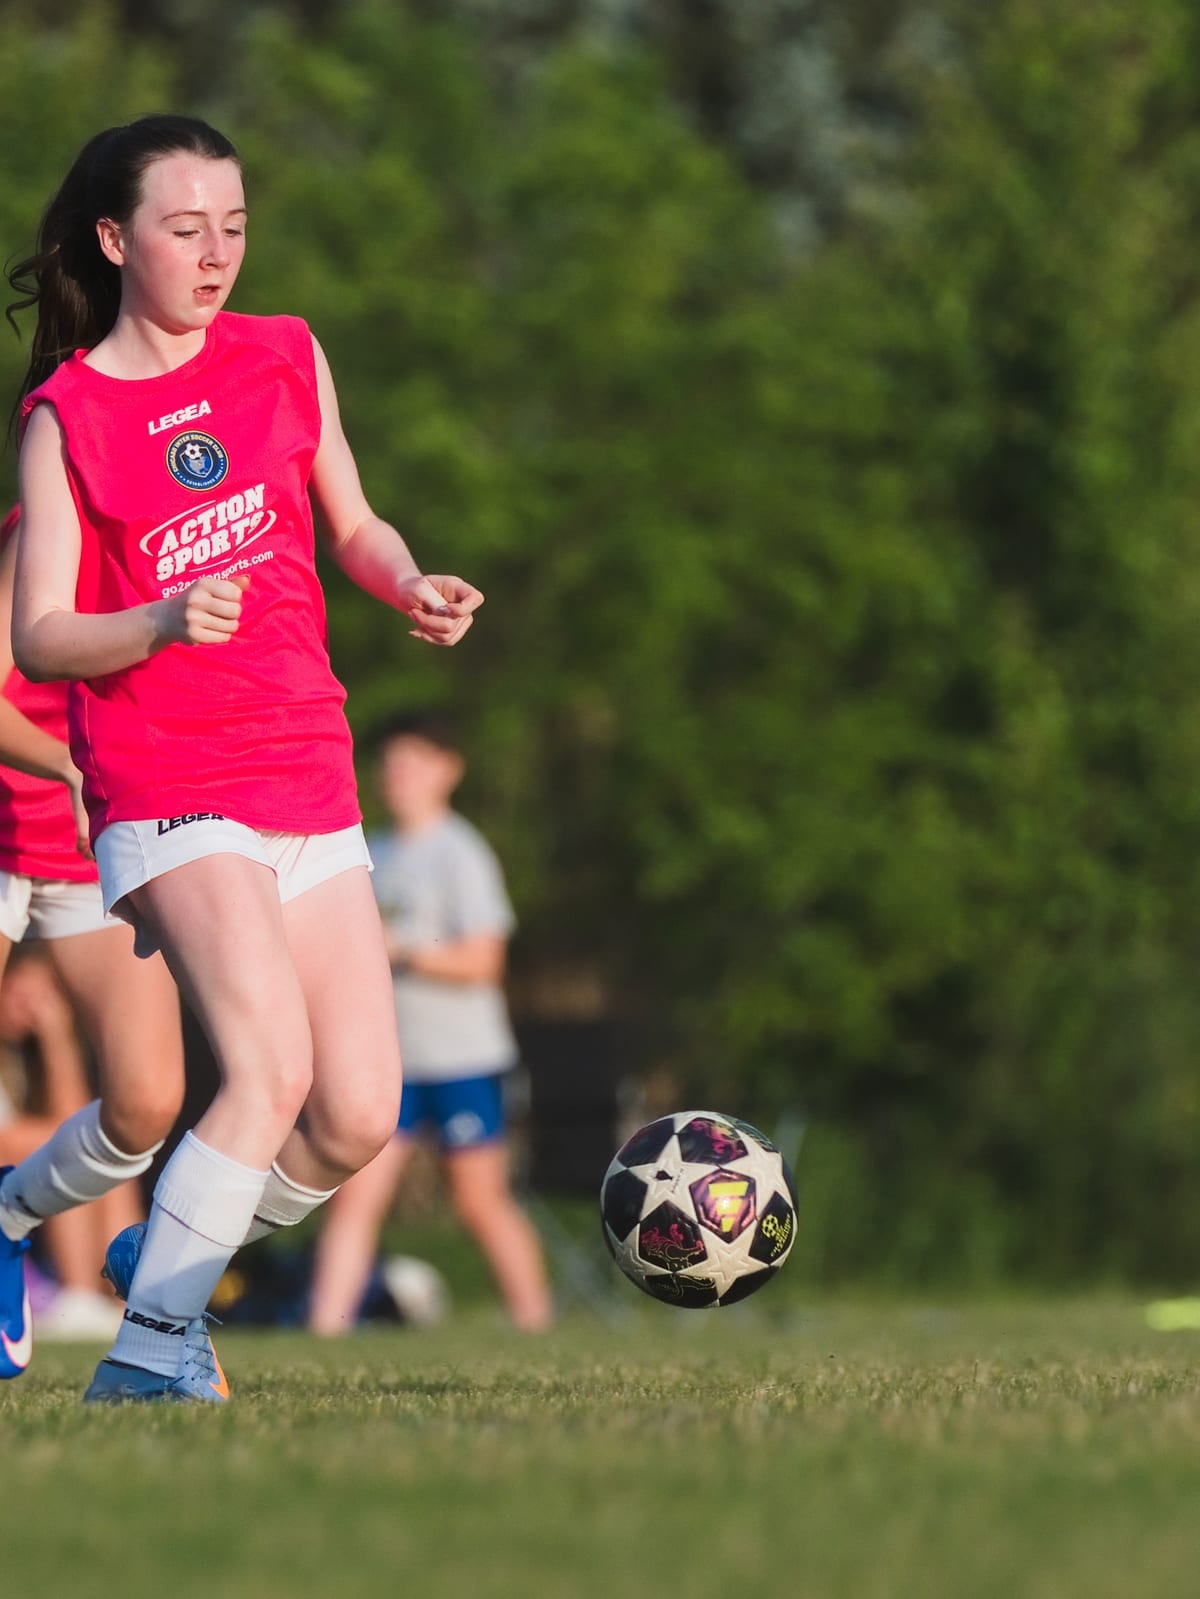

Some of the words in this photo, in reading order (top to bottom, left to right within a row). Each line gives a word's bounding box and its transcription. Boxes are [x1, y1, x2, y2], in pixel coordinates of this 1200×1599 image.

[149, 400, 212, 436] LEGEA
[157, 483, 265, 558] ACTION
[124, 1309, 186, 1336] LEGEA
